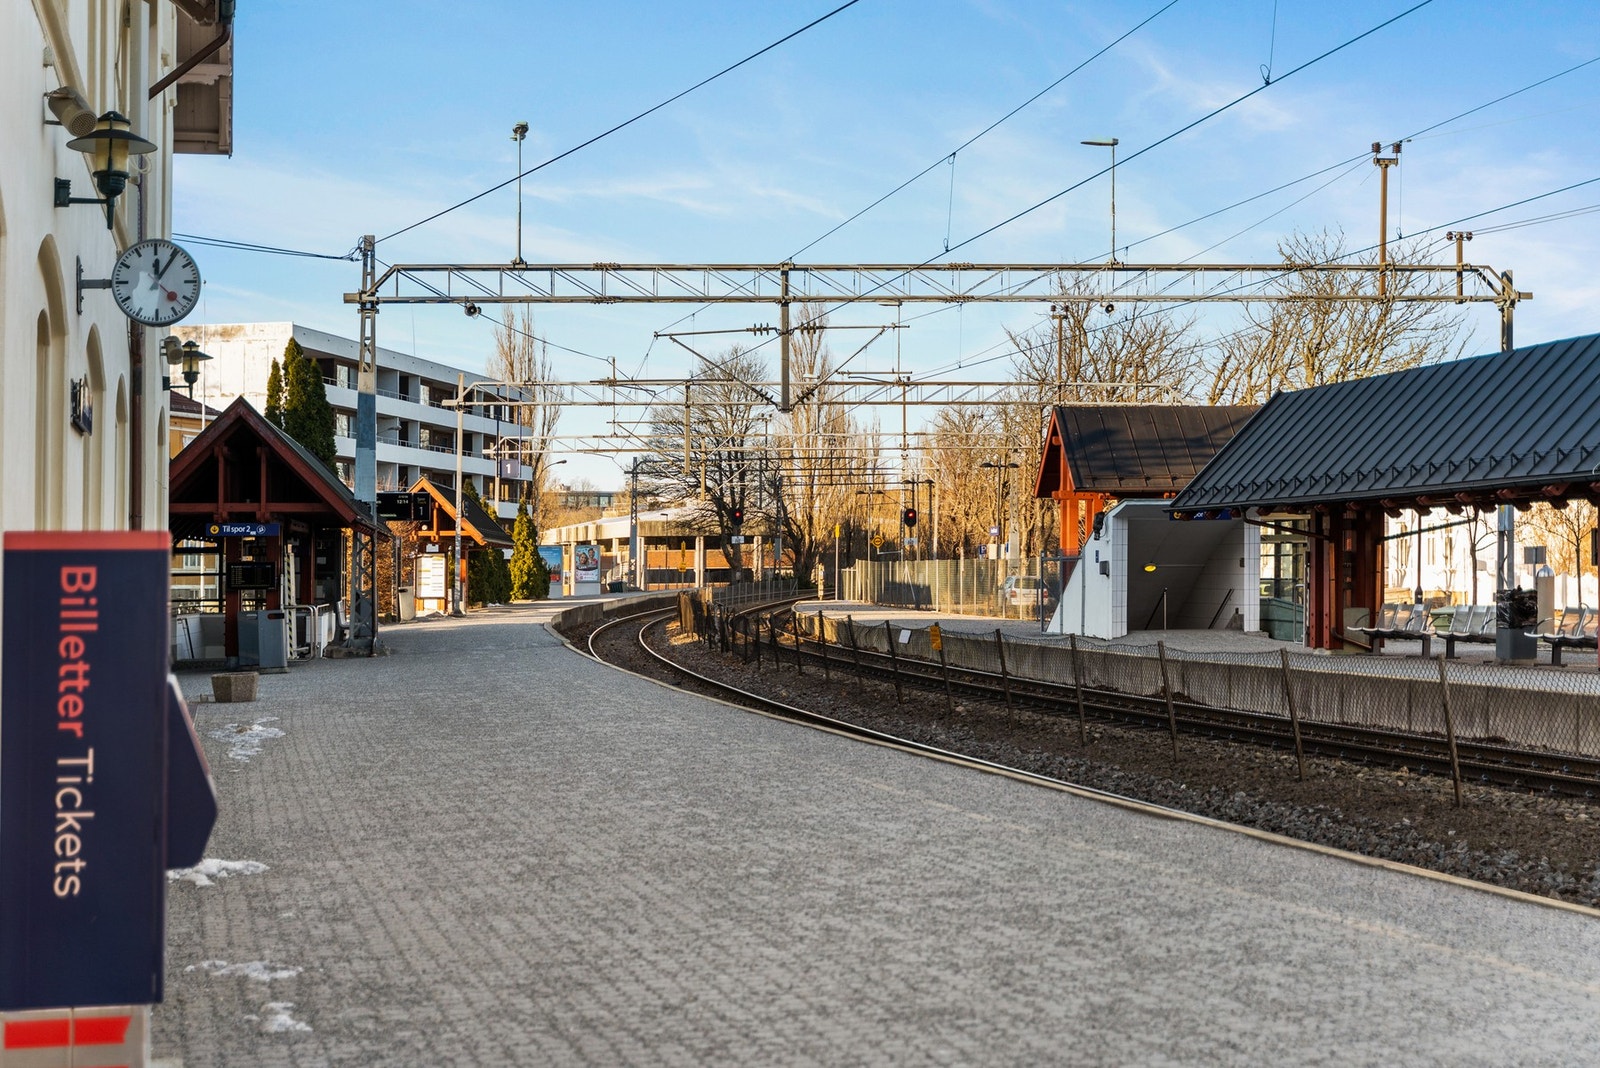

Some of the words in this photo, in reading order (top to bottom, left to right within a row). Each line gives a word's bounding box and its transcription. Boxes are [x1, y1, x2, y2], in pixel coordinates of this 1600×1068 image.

[505, 463, 511, 474] 1
[231, 526, 245, 534] spor
[246, 525, 251, 533] 2
[58, 566, 98, 738] Billetter
[54, 748, 95, 898] Tickets
